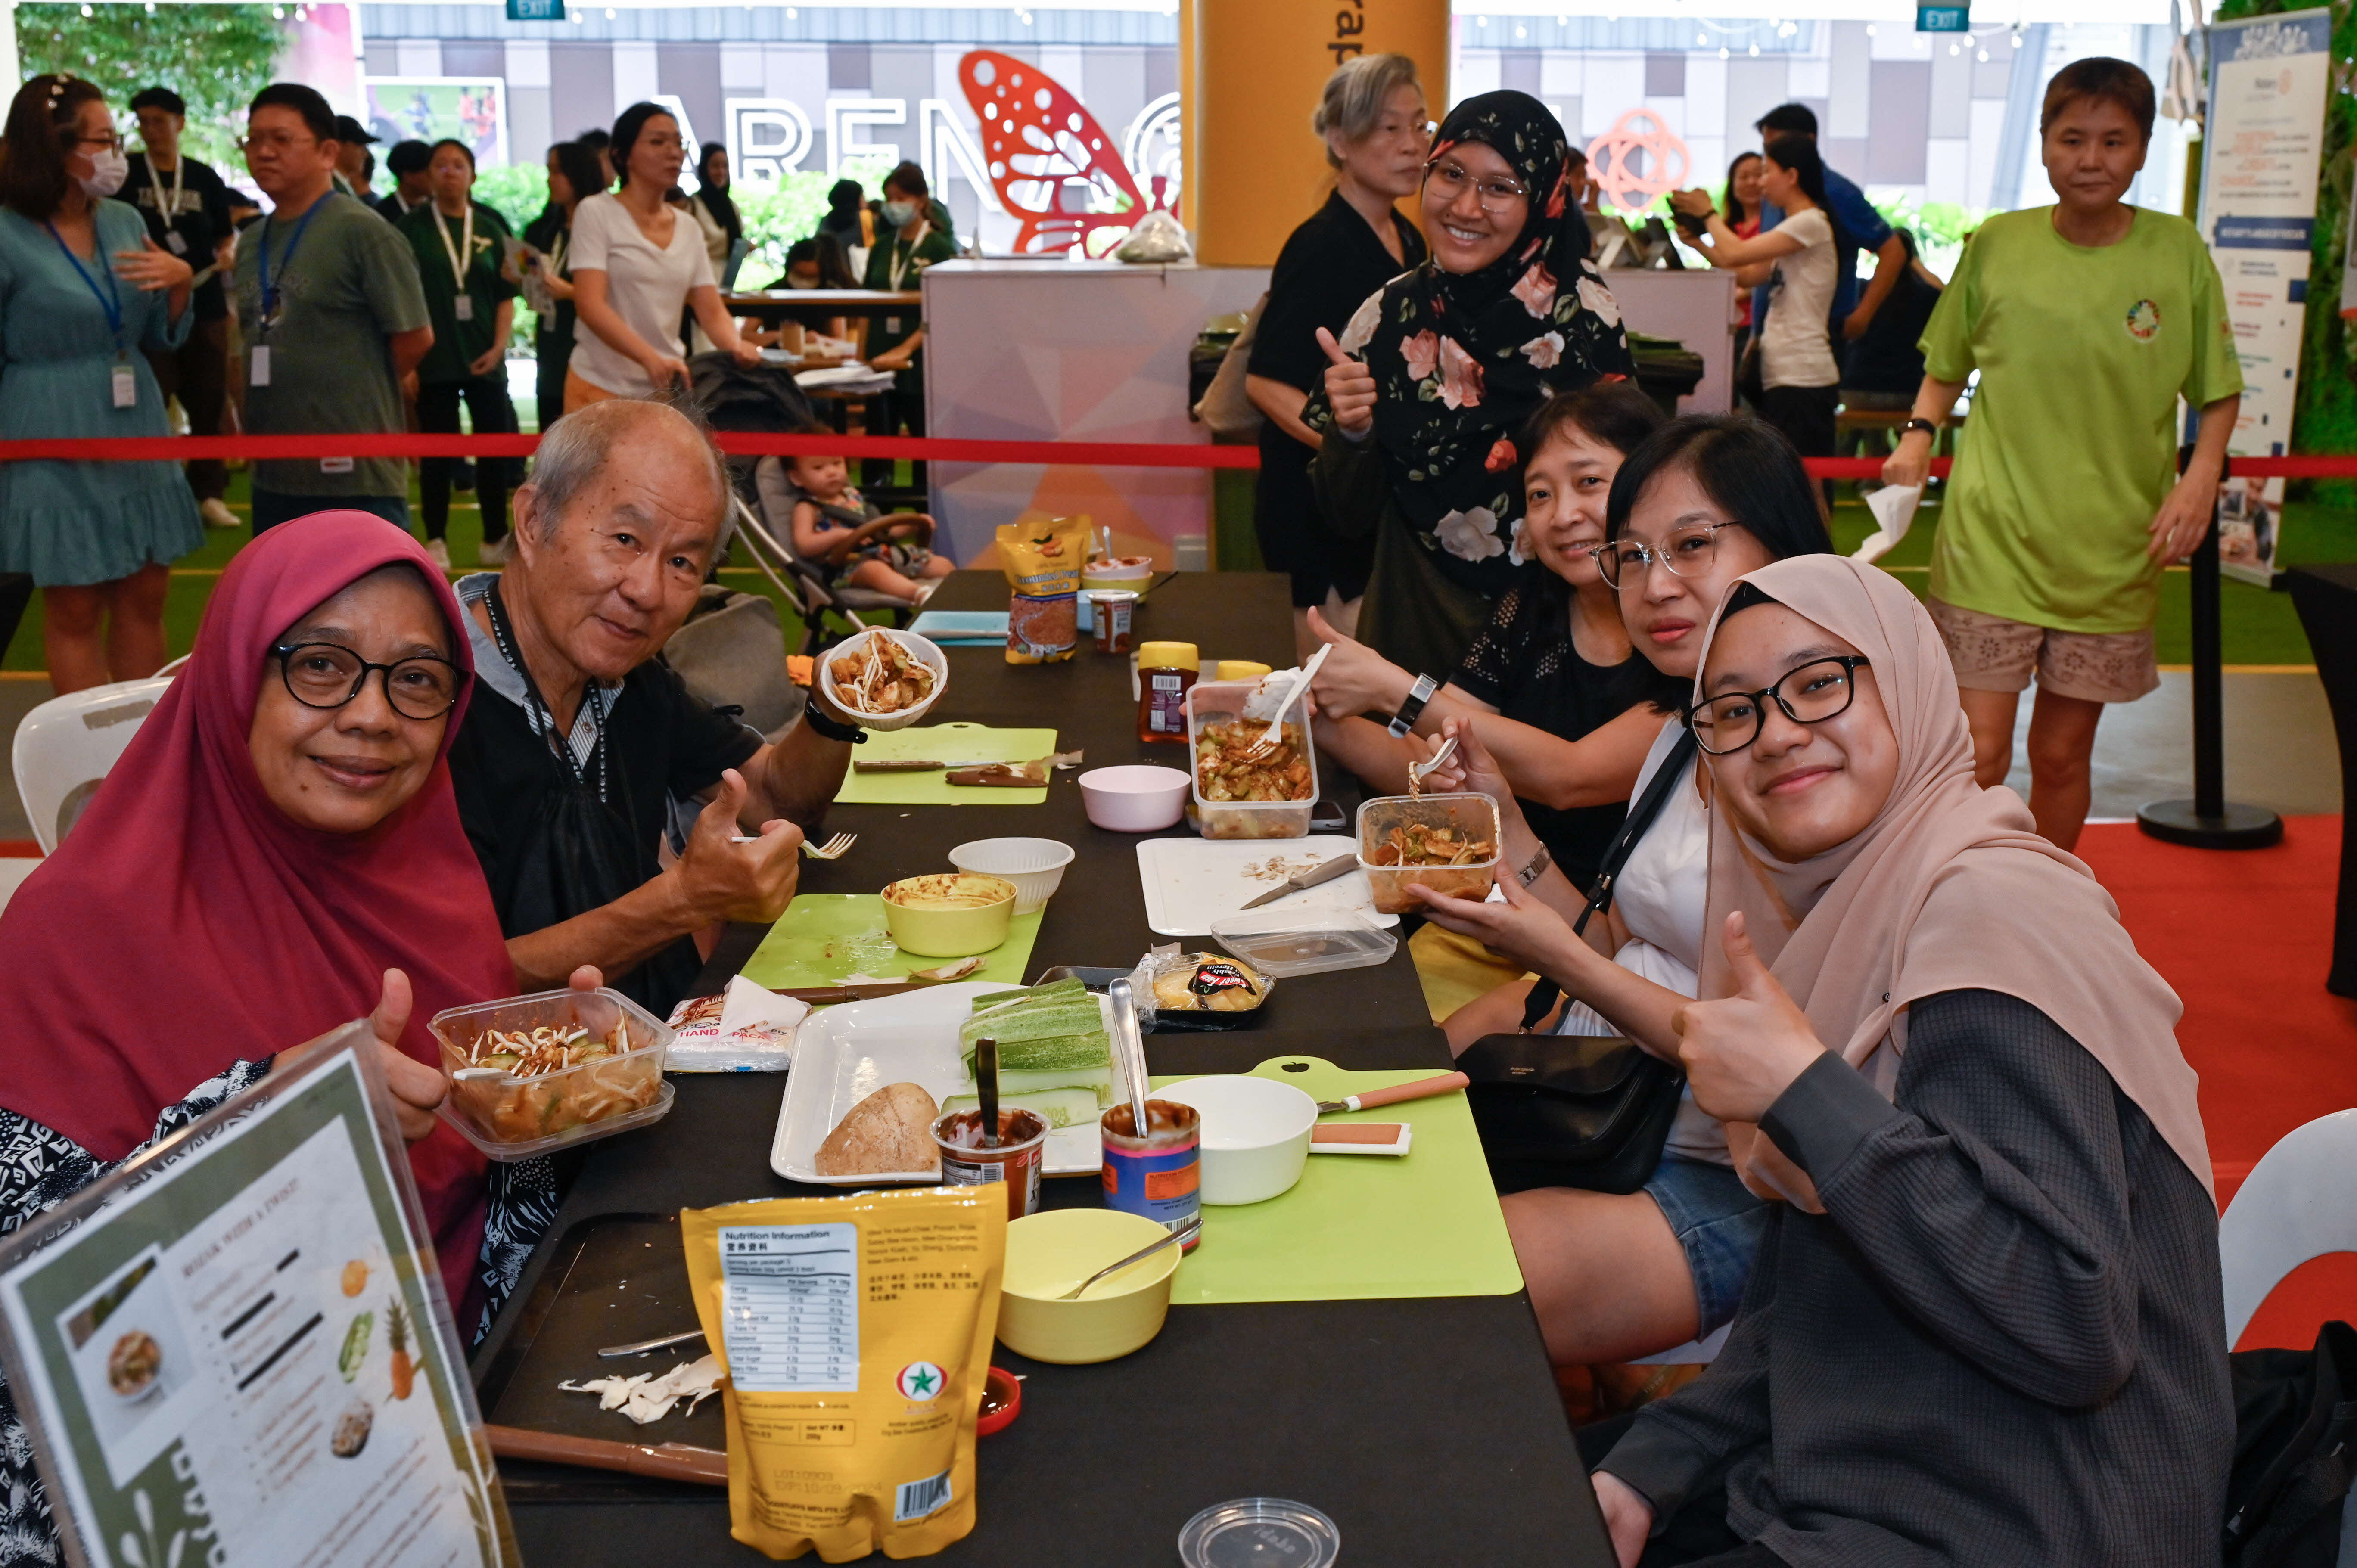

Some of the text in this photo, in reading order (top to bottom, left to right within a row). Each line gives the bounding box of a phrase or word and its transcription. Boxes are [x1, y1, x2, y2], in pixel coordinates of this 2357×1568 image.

[1926, 10, 1959, 28] EXIT
[1200, 974, 1220, 987] Farm
[1219, 977, 1246, 988] Sweet
[680, 1029, 719, 1037] HAND
[772, 1230, 830, 1239] Information
